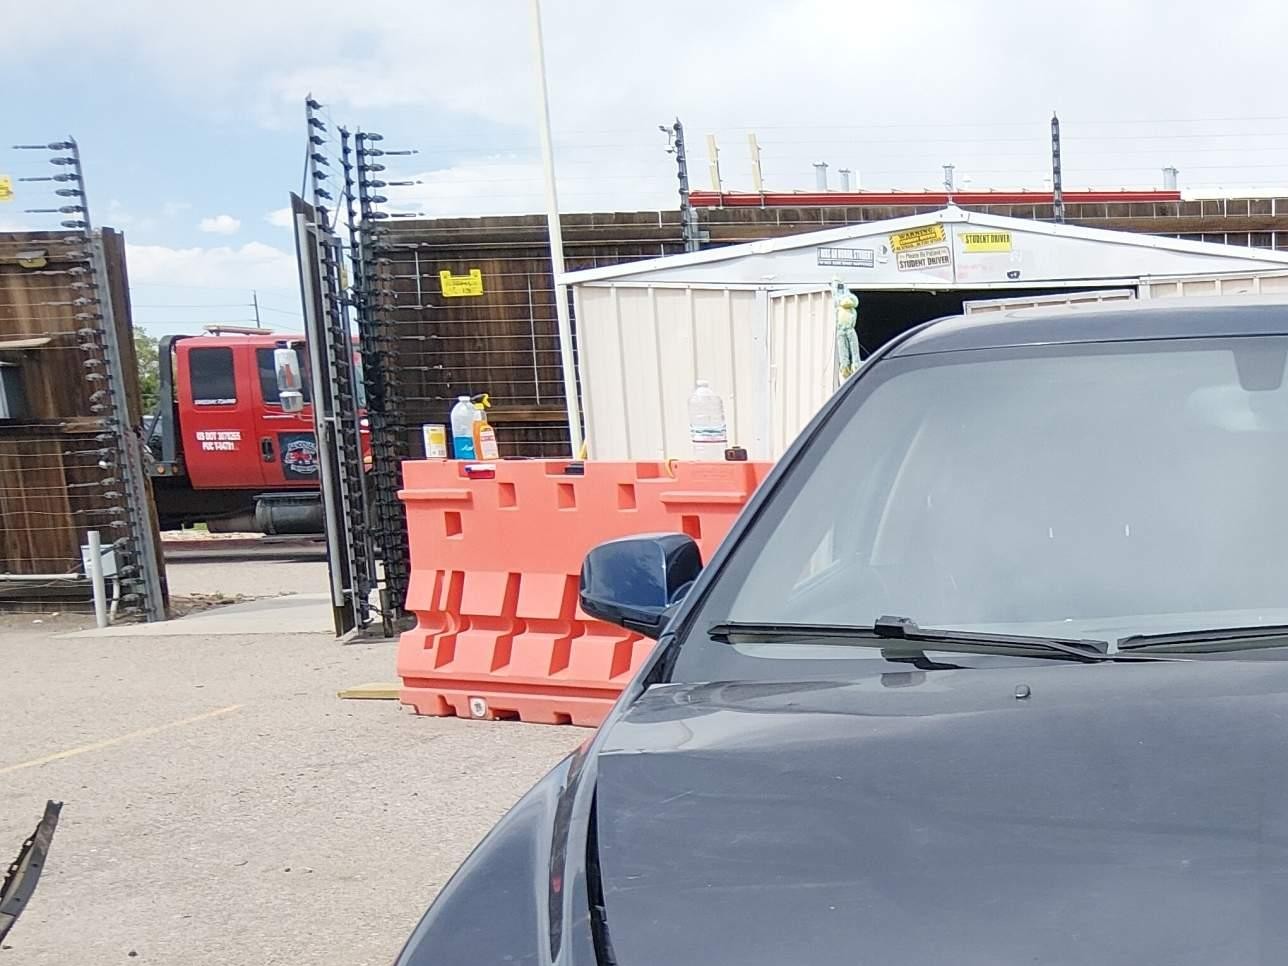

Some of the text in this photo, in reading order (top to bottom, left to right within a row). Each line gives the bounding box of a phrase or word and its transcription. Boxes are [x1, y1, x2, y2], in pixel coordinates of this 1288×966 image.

[965, 234, 1010, 244] STUDENT DRIVER
[899, 255, 950, 269] STUDENT DRIVER
